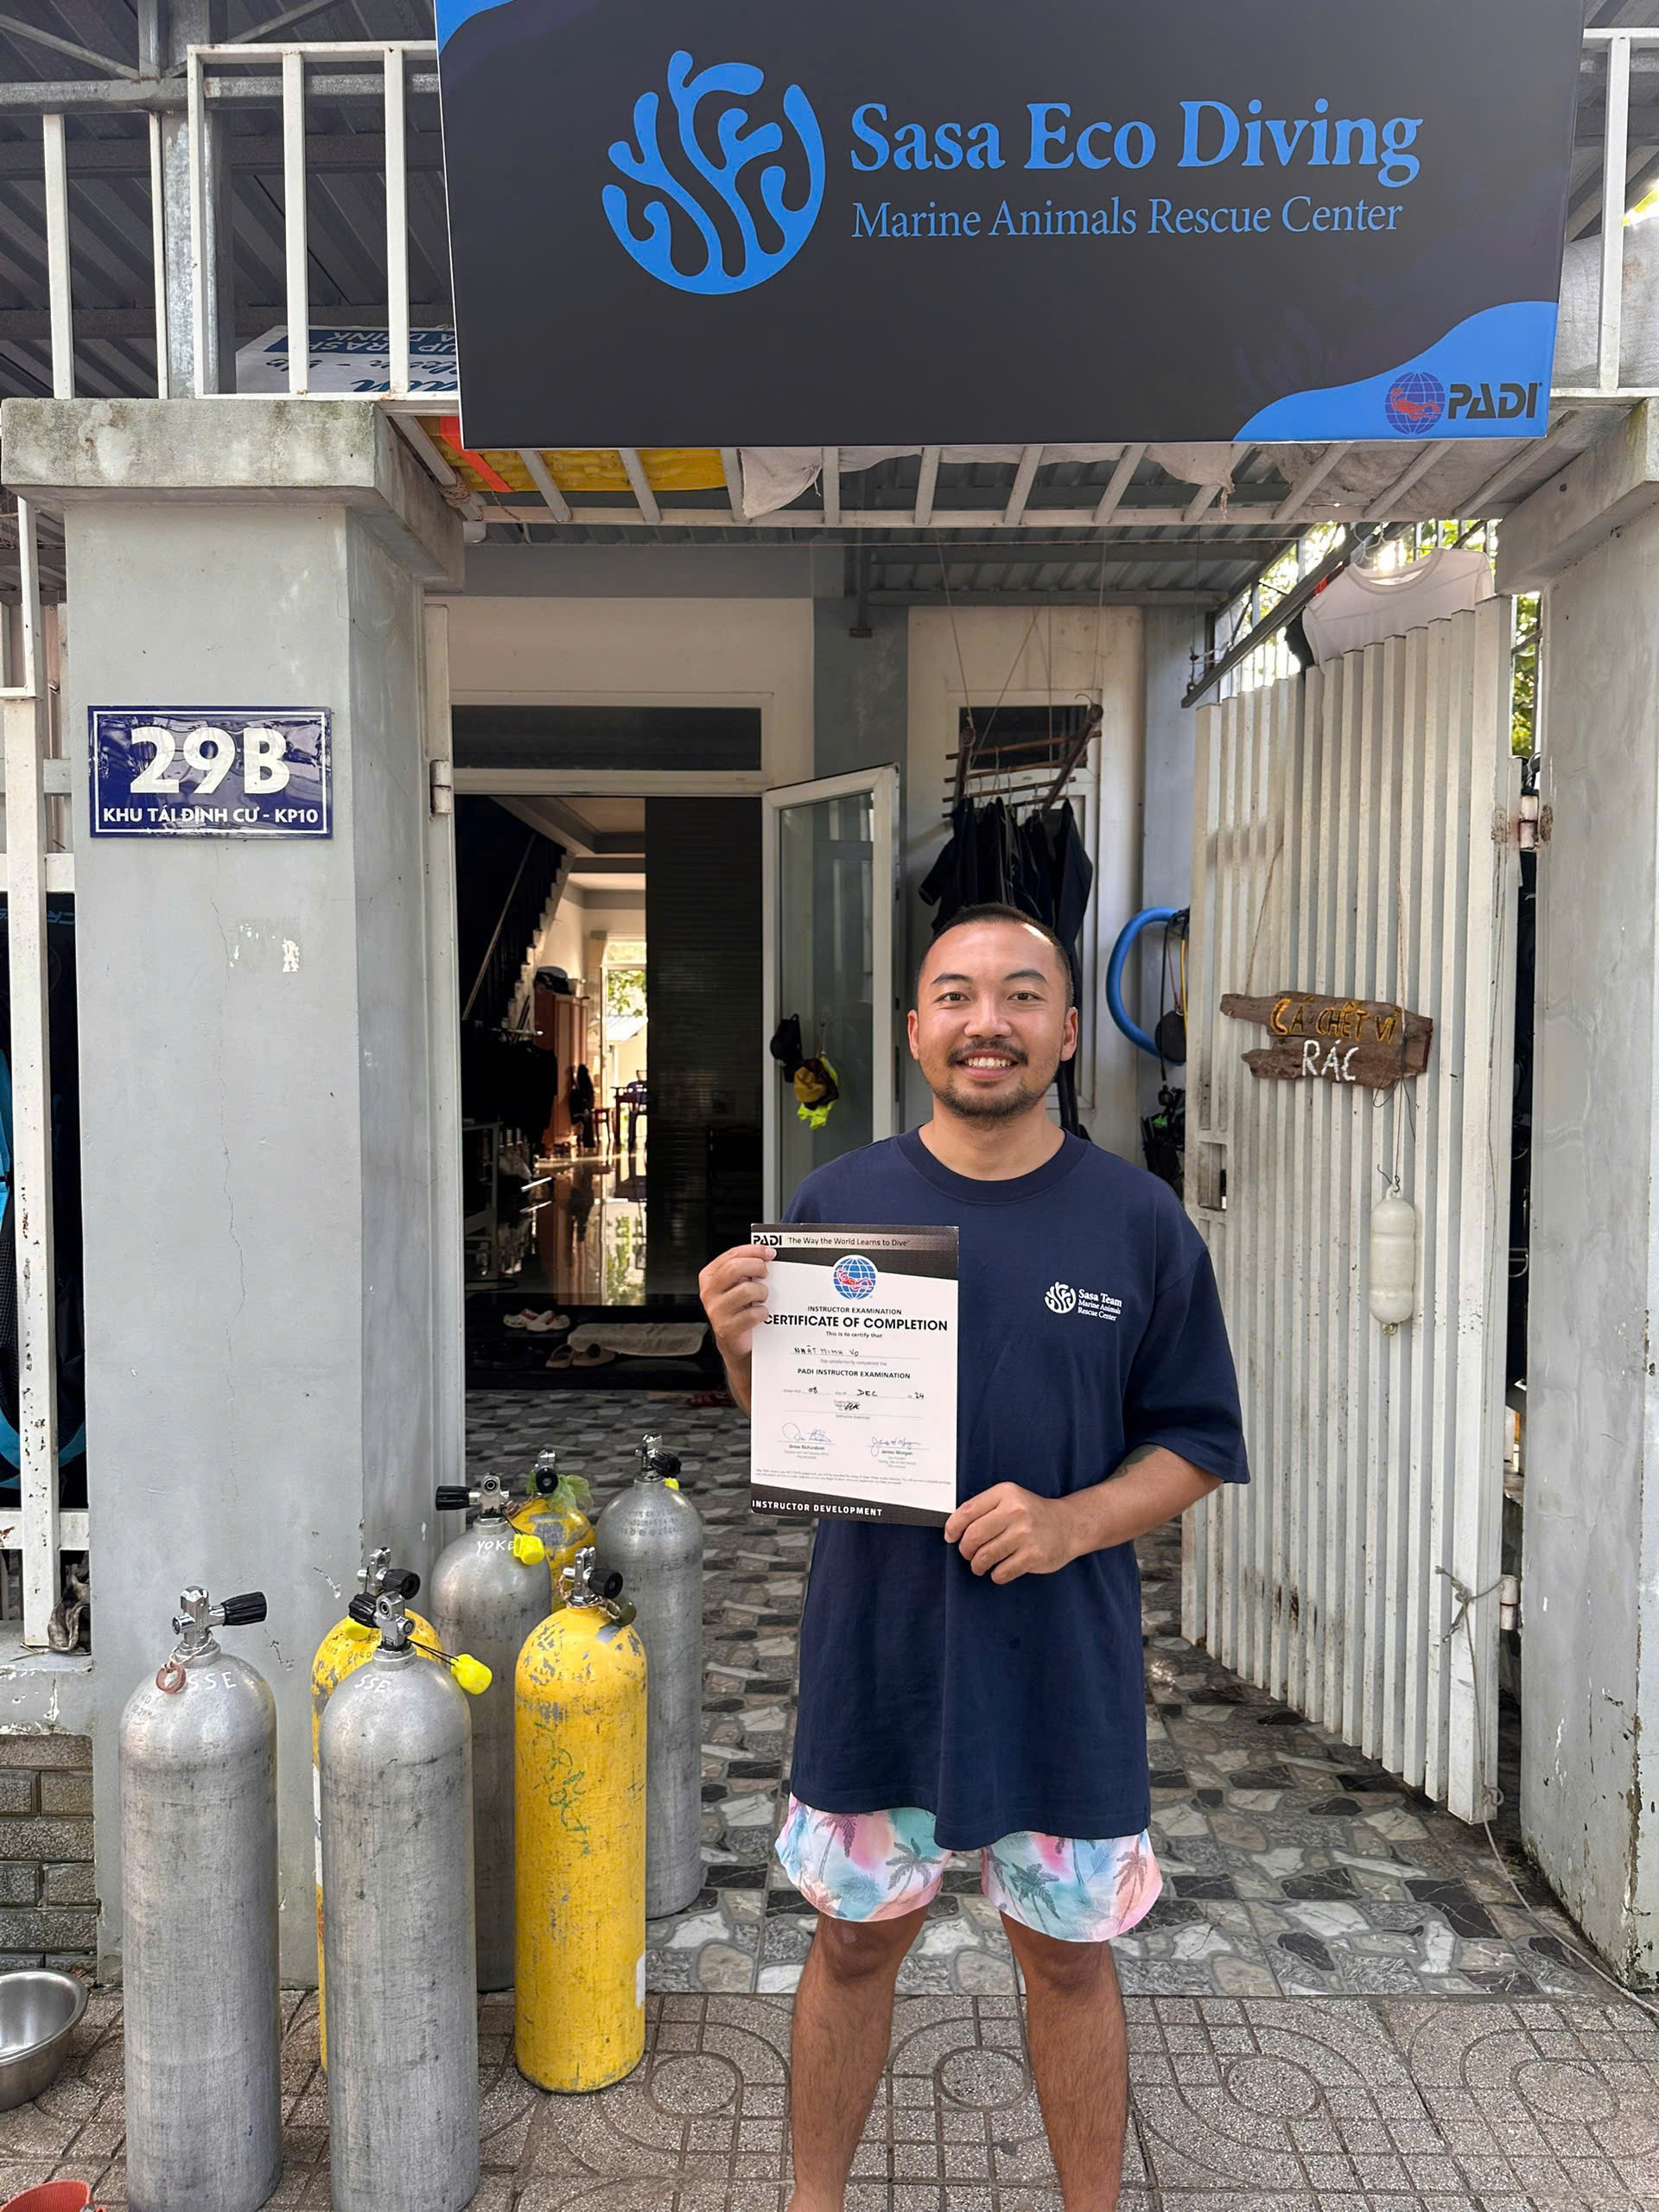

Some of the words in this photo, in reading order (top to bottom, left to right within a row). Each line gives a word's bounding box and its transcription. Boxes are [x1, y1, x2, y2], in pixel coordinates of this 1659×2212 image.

[850, 102, 1006, 171] Sasa
[1023, 102, 1157, 170] Eco
[1176, 98, 1424, 188] Diving
[851, 200, 982, 238] Marine
[988, 195, 1137, 235] Animals
[1147, 197, 1272, 234] Rescue
[1281, 195, 1403, 232] Center
[1447, 382, 1539, 420] PADI
[130, 726, 291, 794] 29B
[103, 807, 143, 823] KHU
[147, 804, 176, 823] TÁI
[180, 806, 228, 824] ĐỊNH
[232, 805, 260, 823] CƯ
[275, 809, 319, 823] KP10
[1269, 995, 1316, 1036] CÁ
[1301, 1039, 1360, 1081] RÁC
[753, 1235, 783, 1246] PADI
[803, 1237, 819, 1246] Way
[833, 1237, 855, 1246] World
[1077, 1299, 1100, 1310] Marine
[1099, 1303, 1122, 1315] Animals
[1078, 1288, 1099, 1302] Sasa
[1100, 1293, 1122, 1307] Team
[807, 1306, 850, 1314] INSTRUCTOR
[851, 1306, 902, 1315] EXAMINATION
[1077, 1306, 1098, 1318] Rescue
[1098, 1311, 1117, 1321] Center
[763, 1313, 839, 1327] CERTIFICATE
[842, 1316, 860, 1329] OF
[863, 1317, 949, 1332] COMPLETION
[816, 1369, 859, 1377] INSTRUCTOR
[860, 1370, 911, 1379] EXAMINATION
[856, 1389, 878, 1397] DEC
[752, 1499, 810, 1511] INSTRUCTOR
[813, 1504, 883, 1516] DEVELOPMENT
[354, 1674, 391, 1693] SSE
